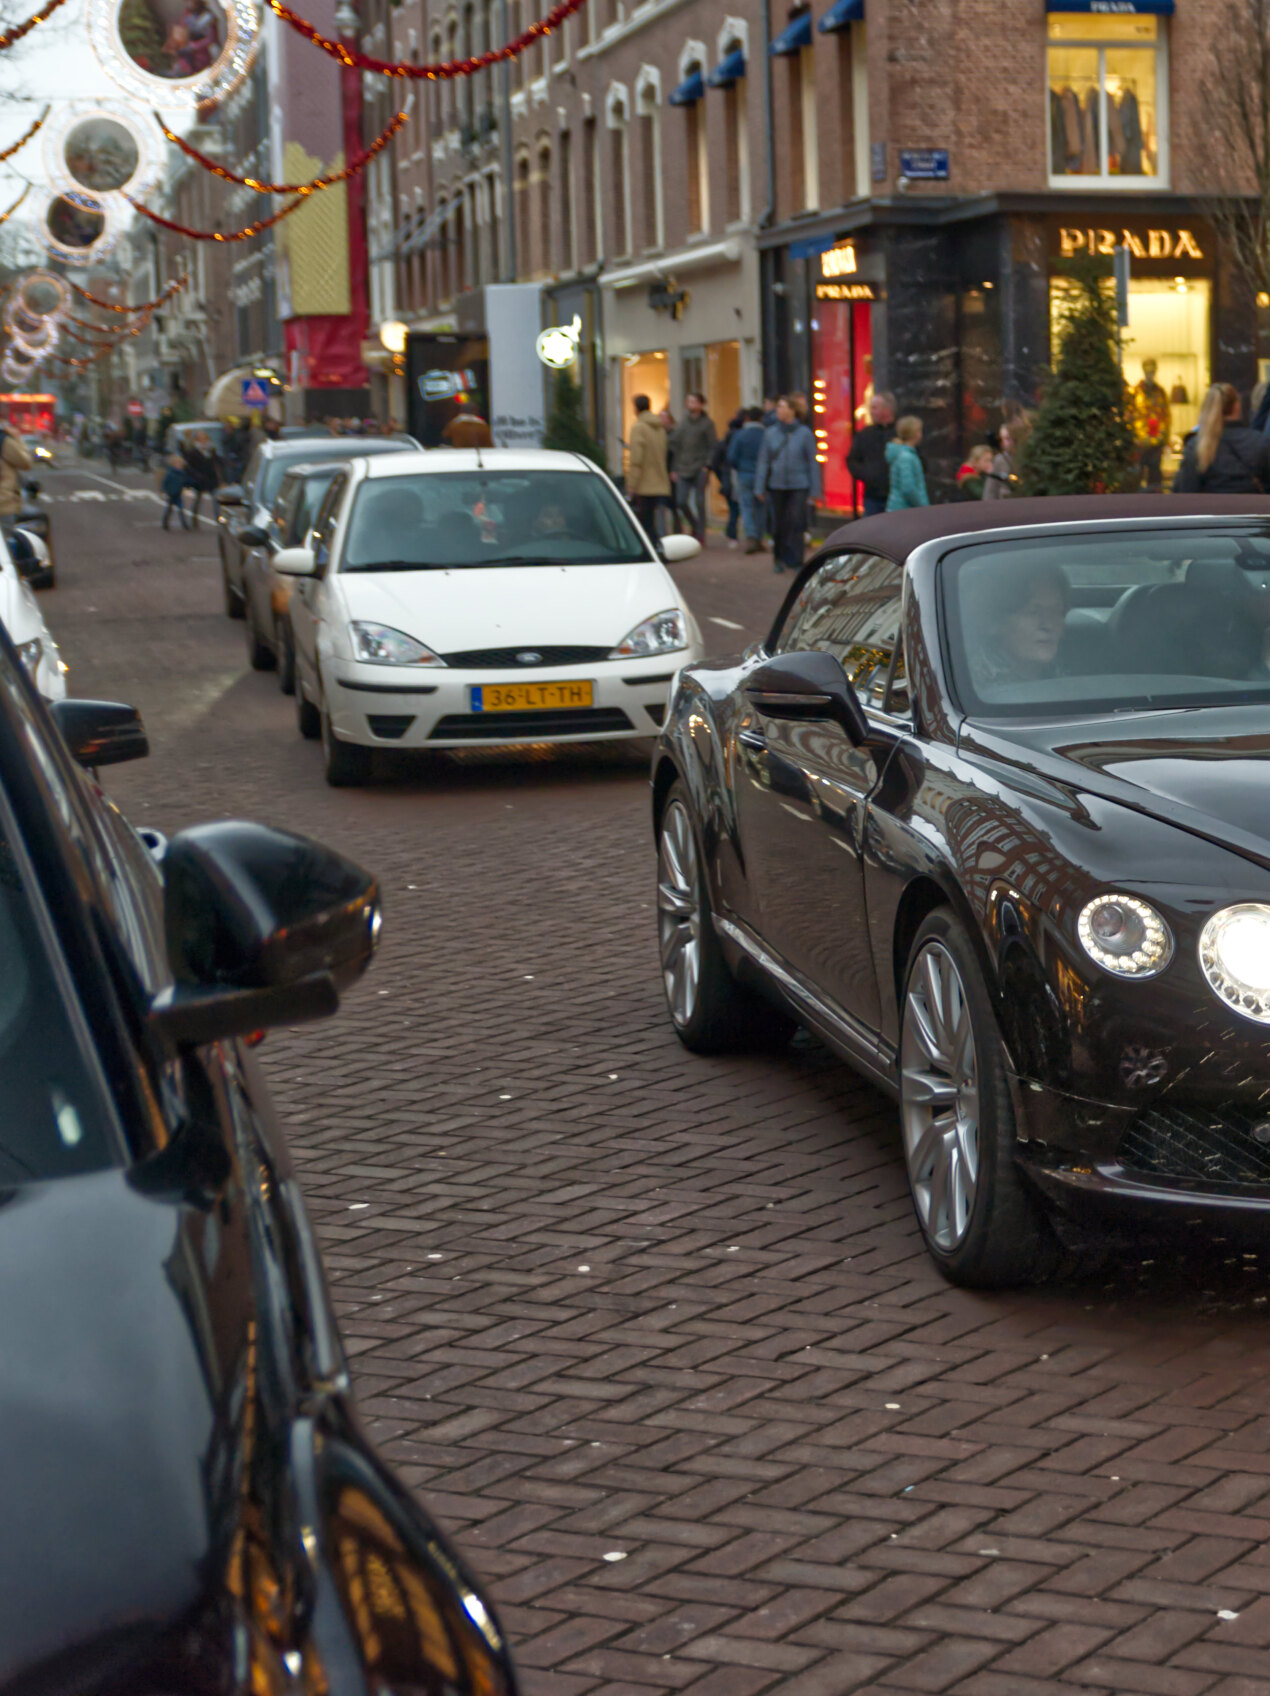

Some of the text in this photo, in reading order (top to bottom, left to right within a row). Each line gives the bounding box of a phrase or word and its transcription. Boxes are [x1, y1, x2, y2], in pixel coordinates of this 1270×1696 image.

[1090, 1, 1137, 13] PRADA
[1060, 228, 1204, 259] PRADA
[816, 284, 875, 300] PRADA
[490, 686, 583, 707] 36-LT-TH
